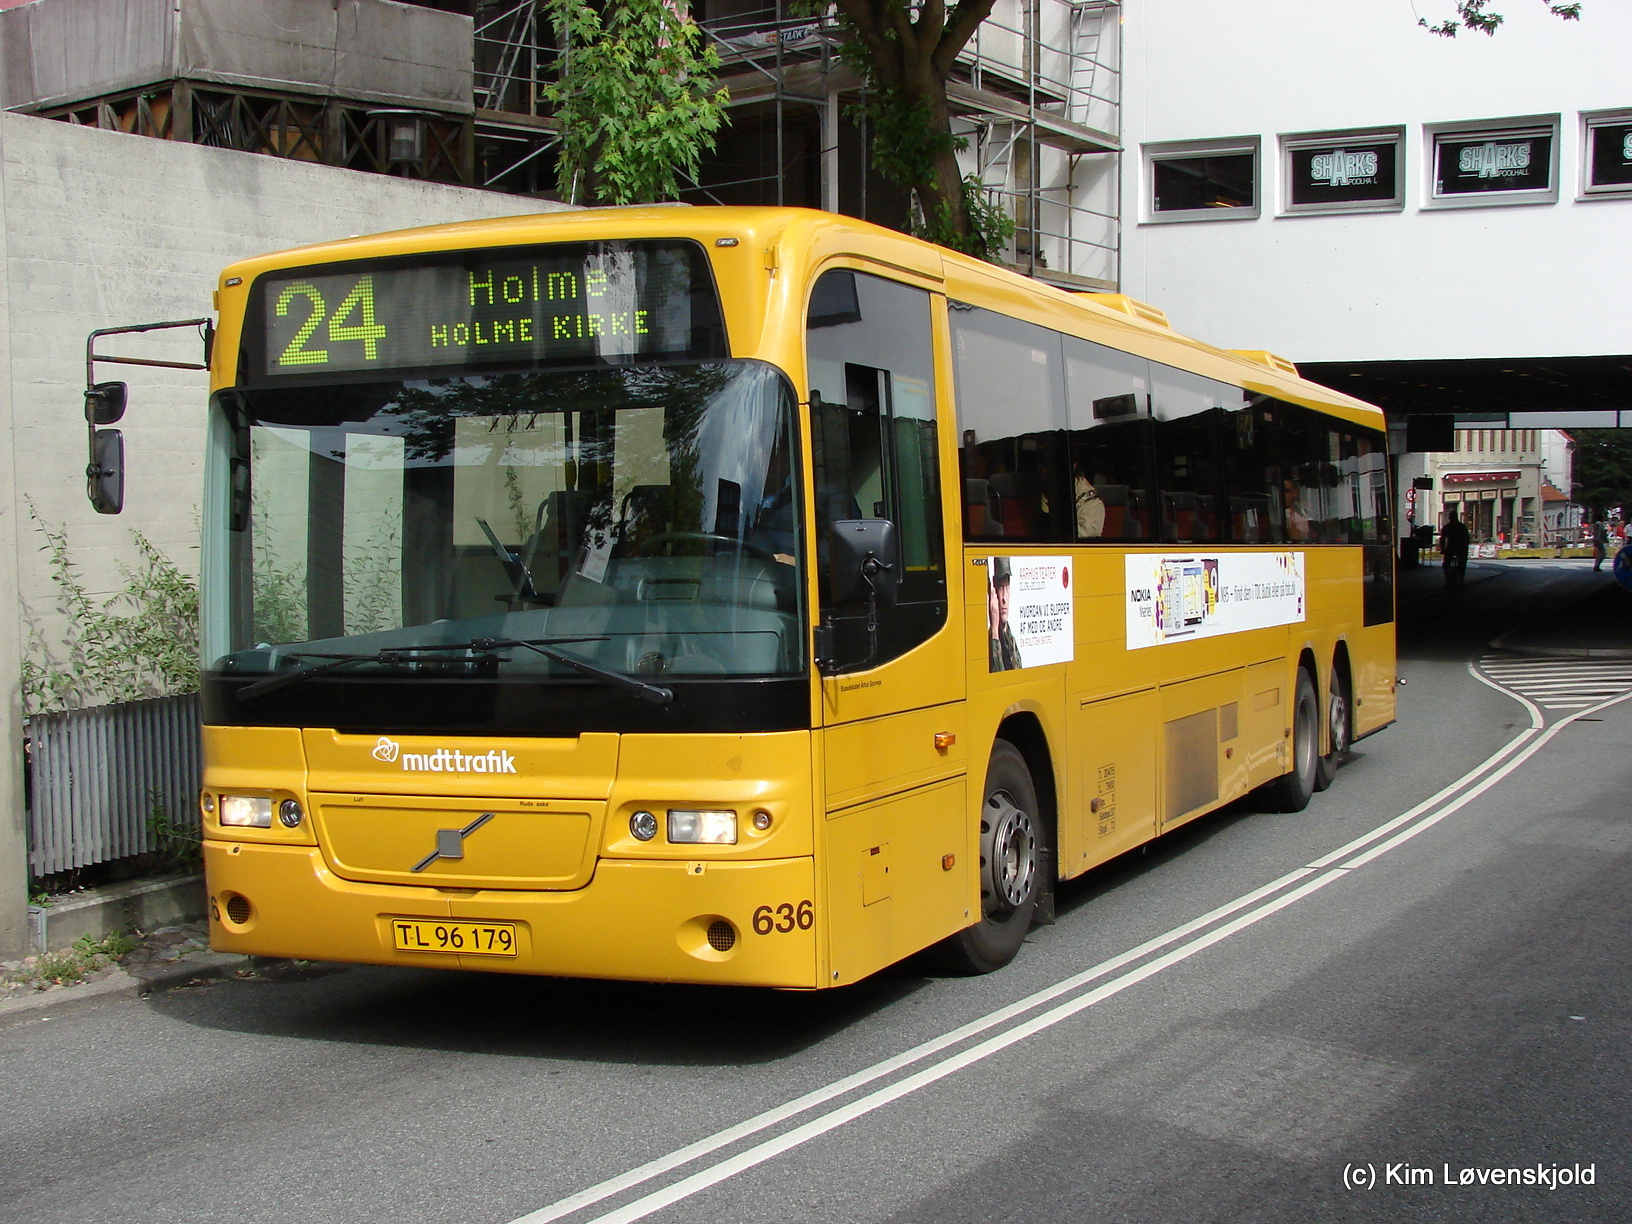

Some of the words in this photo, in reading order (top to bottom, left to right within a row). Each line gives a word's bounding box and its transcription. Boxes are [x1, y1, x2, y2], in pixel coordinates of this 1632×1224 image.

[1310, 149, 1378, 187] SHARKS
[1459, 142, 1531, 178] SHARKS
[1498, 168, 1529, 177] POOLHALL
[1348, 177, 1378, 186] POOLHAL
[468, 265, 609, 306] Holme
[275, 273, 387, 366] 24
[431, 318, 534, 348] HOLME
[553, 310, 649, 340] KIRKE
[1039, 566, 1056, 580] TEATER
[1131, 589, 1152, 603] NOKIA
[1019, 605, 1043, 619] HVORDAN
[1043, 604, 1049, 617] VI
[1050, 603, 1070, 616] SLIPPER
[1020, 622, 1026, 635] AF
[1027, 621, 1038, 634] MED
[1039, 620, 1046, 633] DE
[1047, 618, 1062, 632] ANDRE
[402, 748, 517, 774] midttrafik
[752, 899, 814, 936] 636
[397, 924, 430, 947] TL
[435, 926, 464, 948] 96
[471, 928, 512, 951] 179
